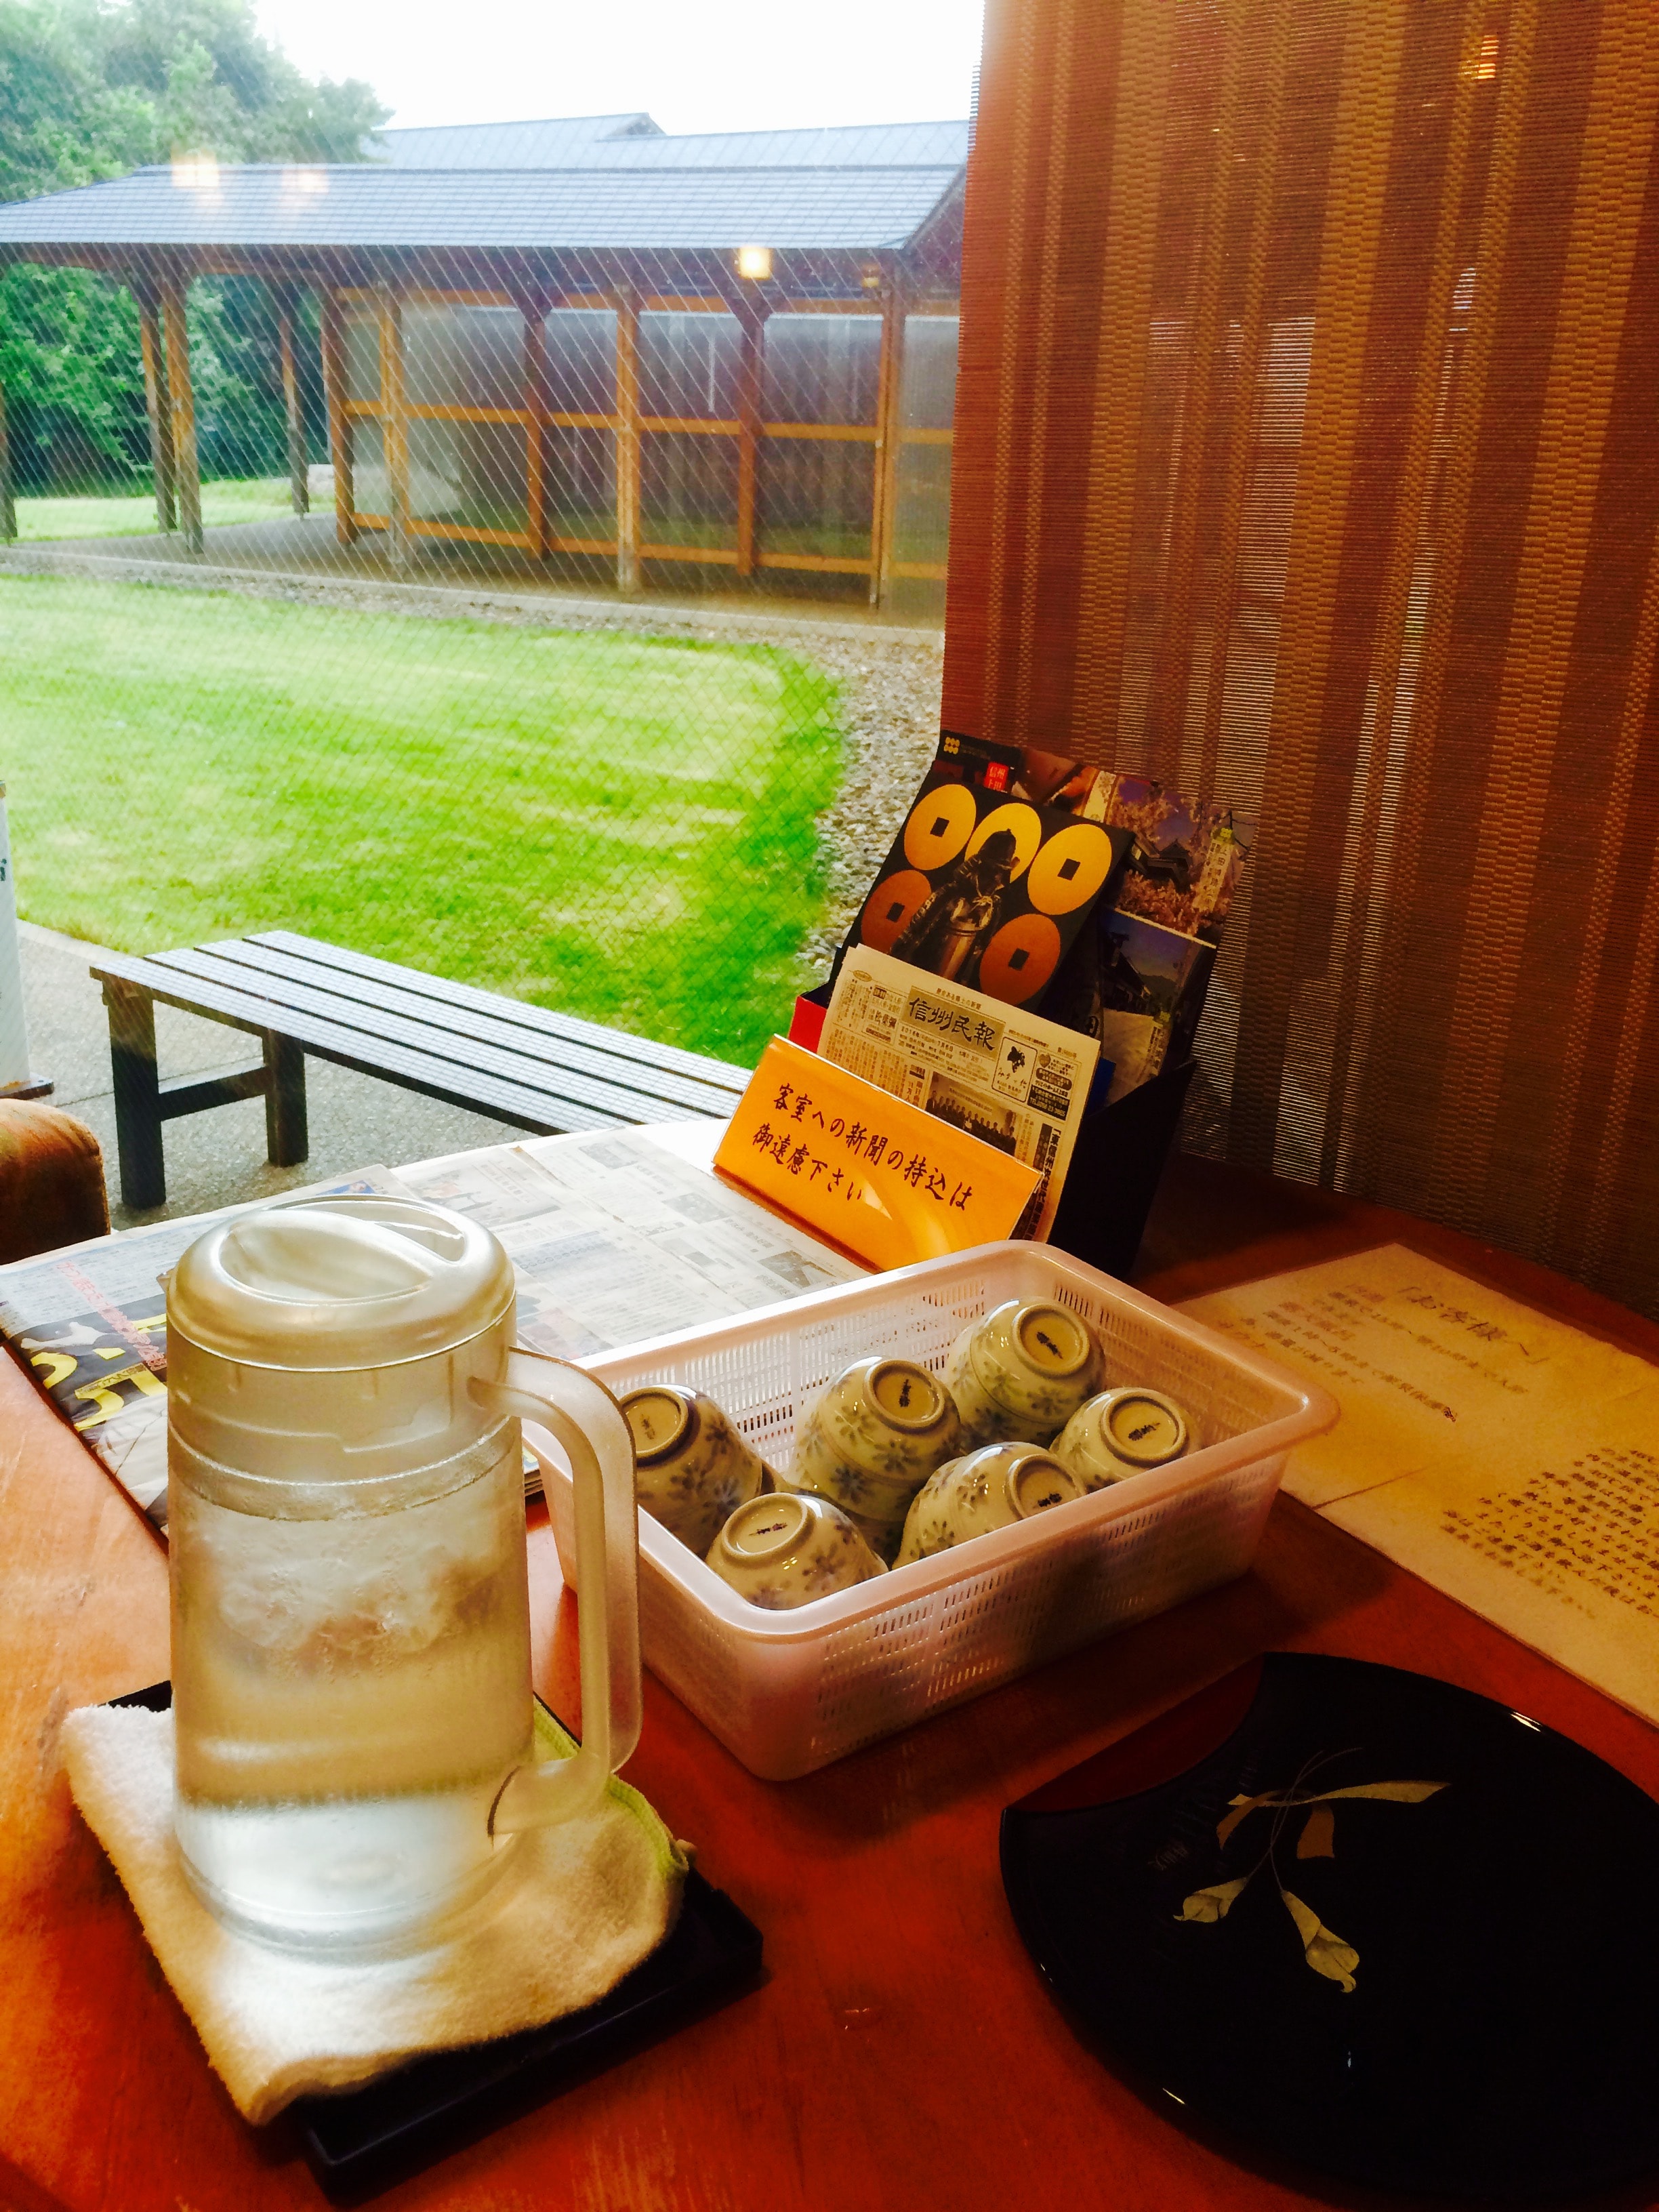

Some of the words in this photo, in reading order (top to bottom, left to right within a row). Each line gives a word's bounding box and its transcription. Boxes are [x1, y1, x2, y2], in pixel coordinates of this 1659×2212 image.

[909, 998, 996, 1050] 信州民報
[752, 1122, 862, 1201] 御遠慮下さい
[773, 1082, 974, 1211] 客室への新聞の持込は
